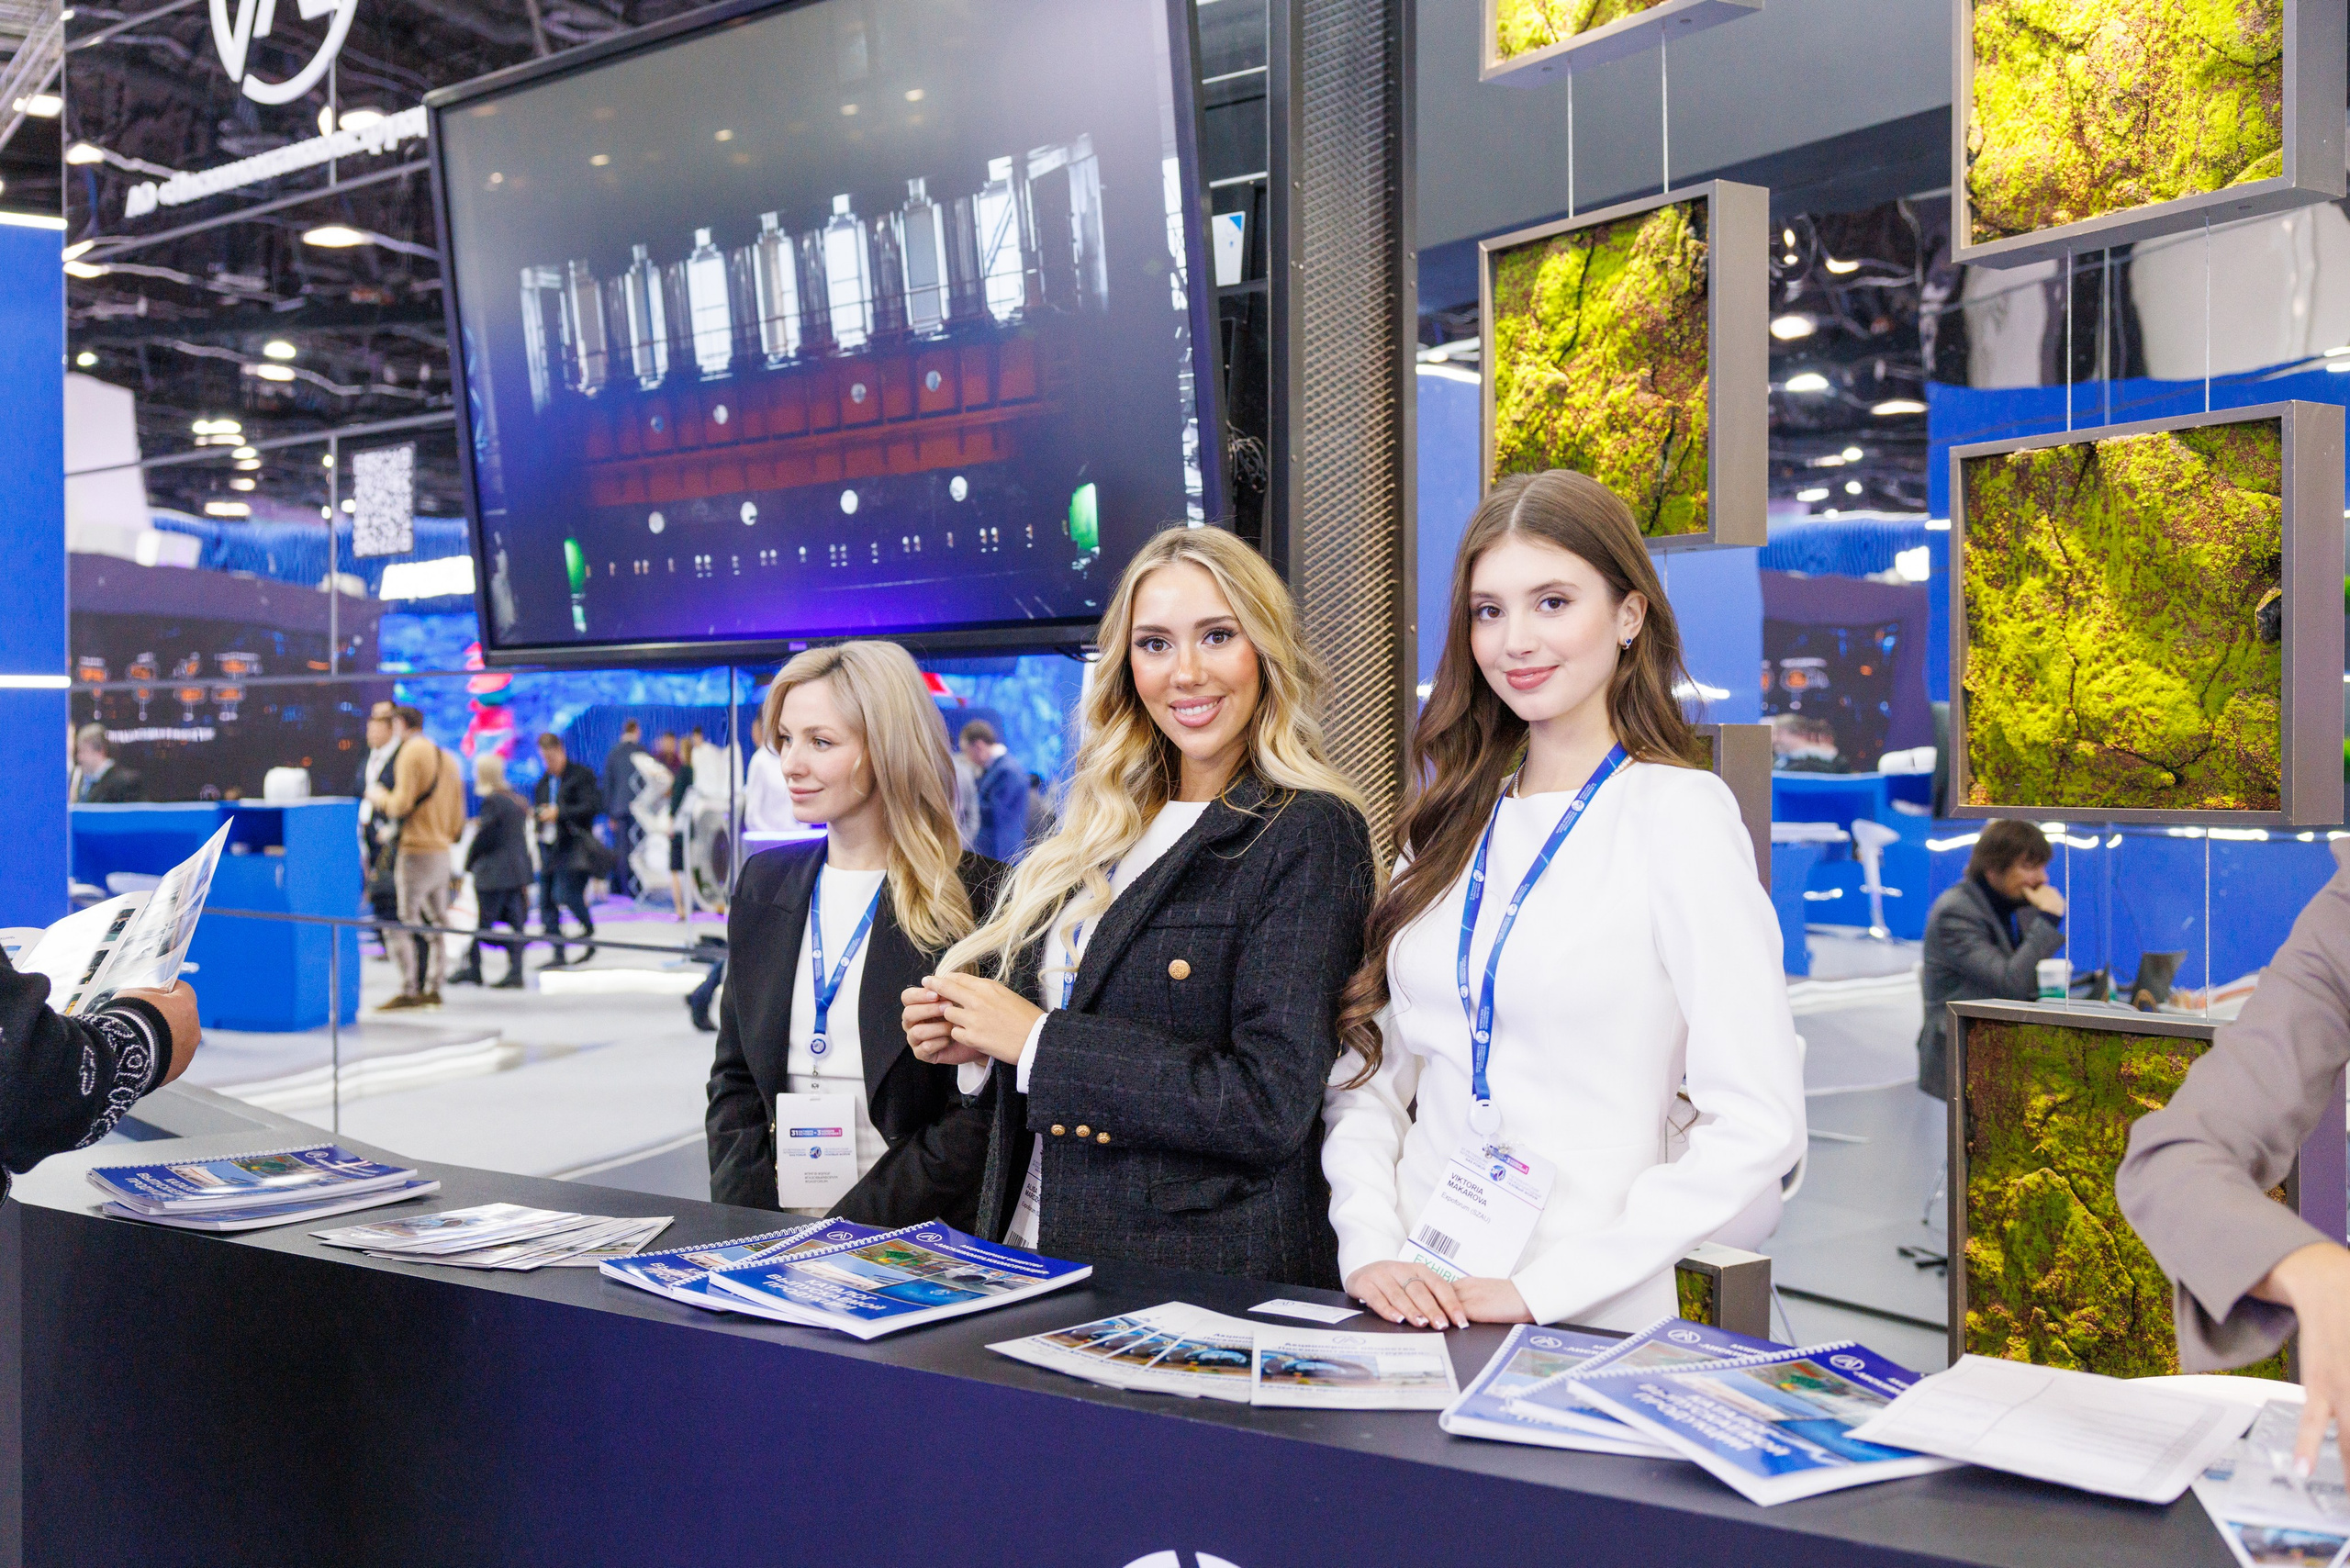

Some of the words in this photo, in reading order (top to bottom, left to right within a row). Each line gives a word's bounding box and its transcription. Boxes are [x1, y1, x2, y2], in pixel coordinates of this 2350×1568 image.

[1447, 1180, 1487, 1207] MAKAROVA
[1450, 1172, 1483, 1195] VIKTORIA
[1440, 1192, 1471, 1213] Expoforum
[1414, 1254, 1462, 1283] EXHIBI
[762, 1281, 858, 1311] ПРОДУКЦИИ
[765, 1273, 888, 1310] ВЫПУСКАЕМОЙ
[805, 1279, 878, 1301] КАТАЛОГ
